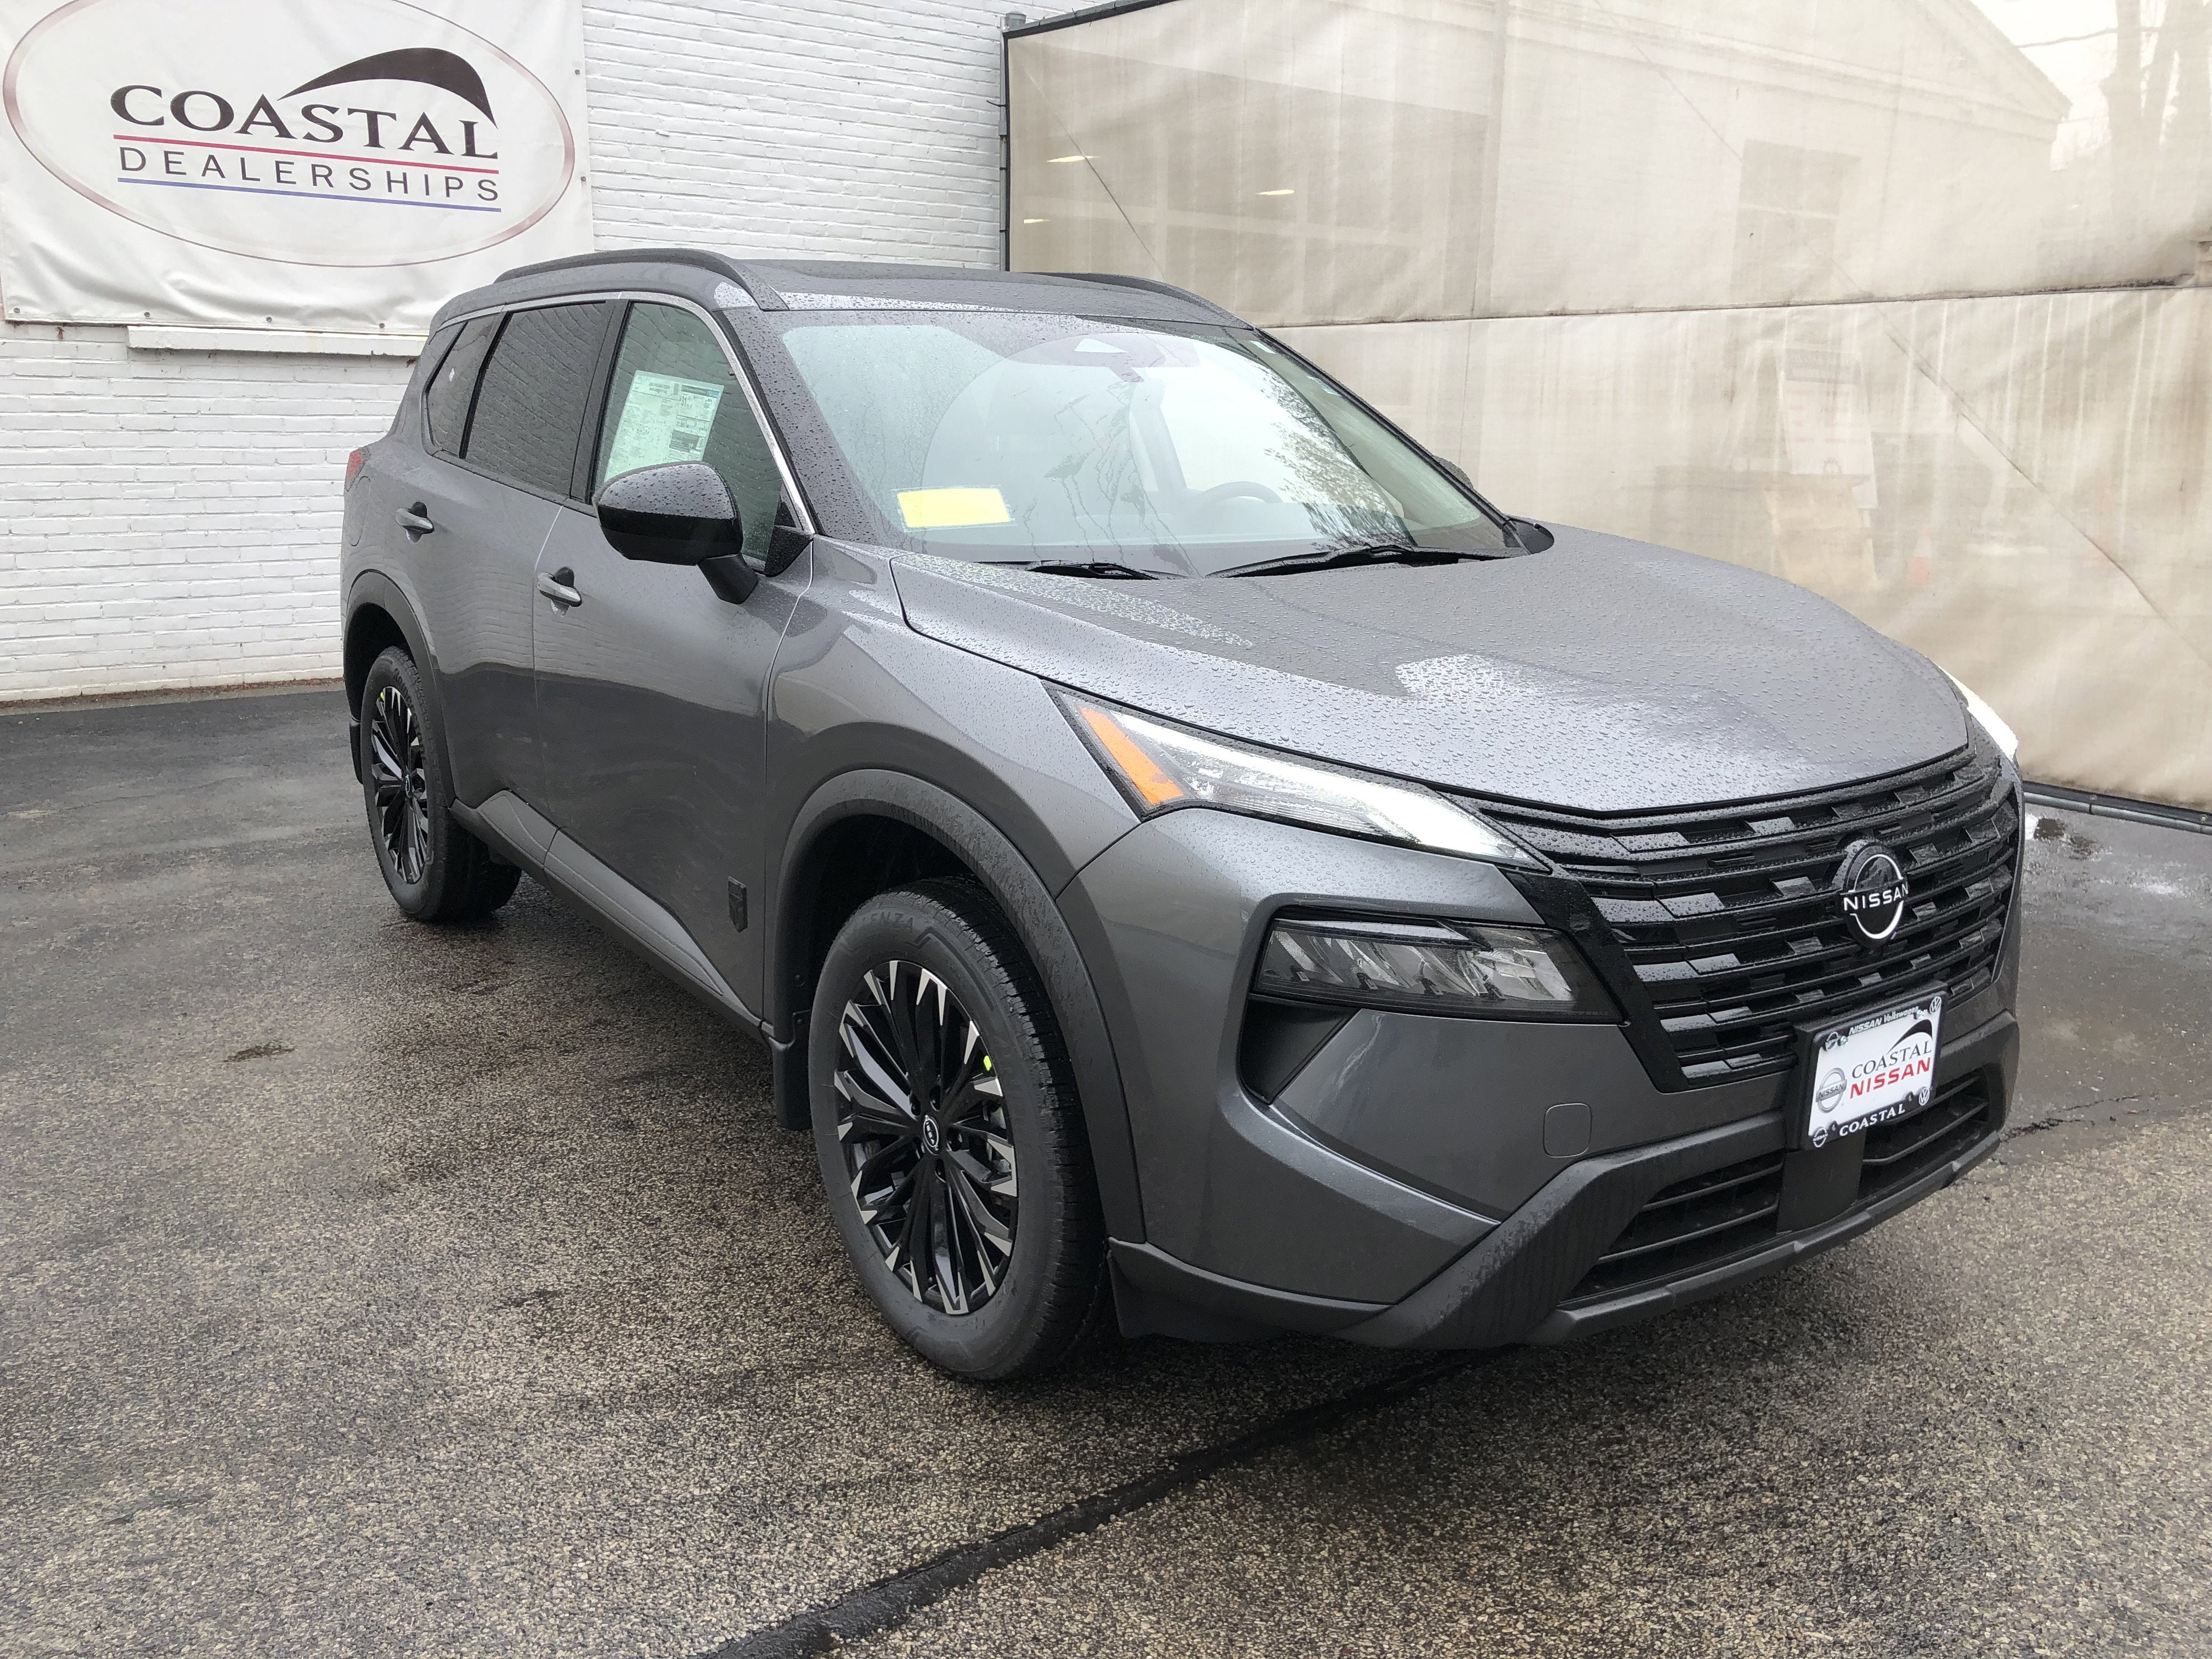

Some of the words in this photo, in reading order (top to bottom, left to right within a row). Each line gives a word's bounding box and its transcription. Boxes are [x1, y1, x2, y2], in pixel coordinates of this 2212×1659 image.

[110, 85, 498, 159] COASTAL
[120, 147, 498, 201] DEALERSHIPS
[1843, 881, 1909, 911] NISSAN
[1849, 1017, 1882, 1035] NISSAN
[1849, 1057, 1931, 1099] NISSAN
[1852, 1041, 1932, 1079] COASTAL
[1818, 1083, 1844, 1097] NISSAN
[1839, 1103, 1905, 1137] COASTAL
